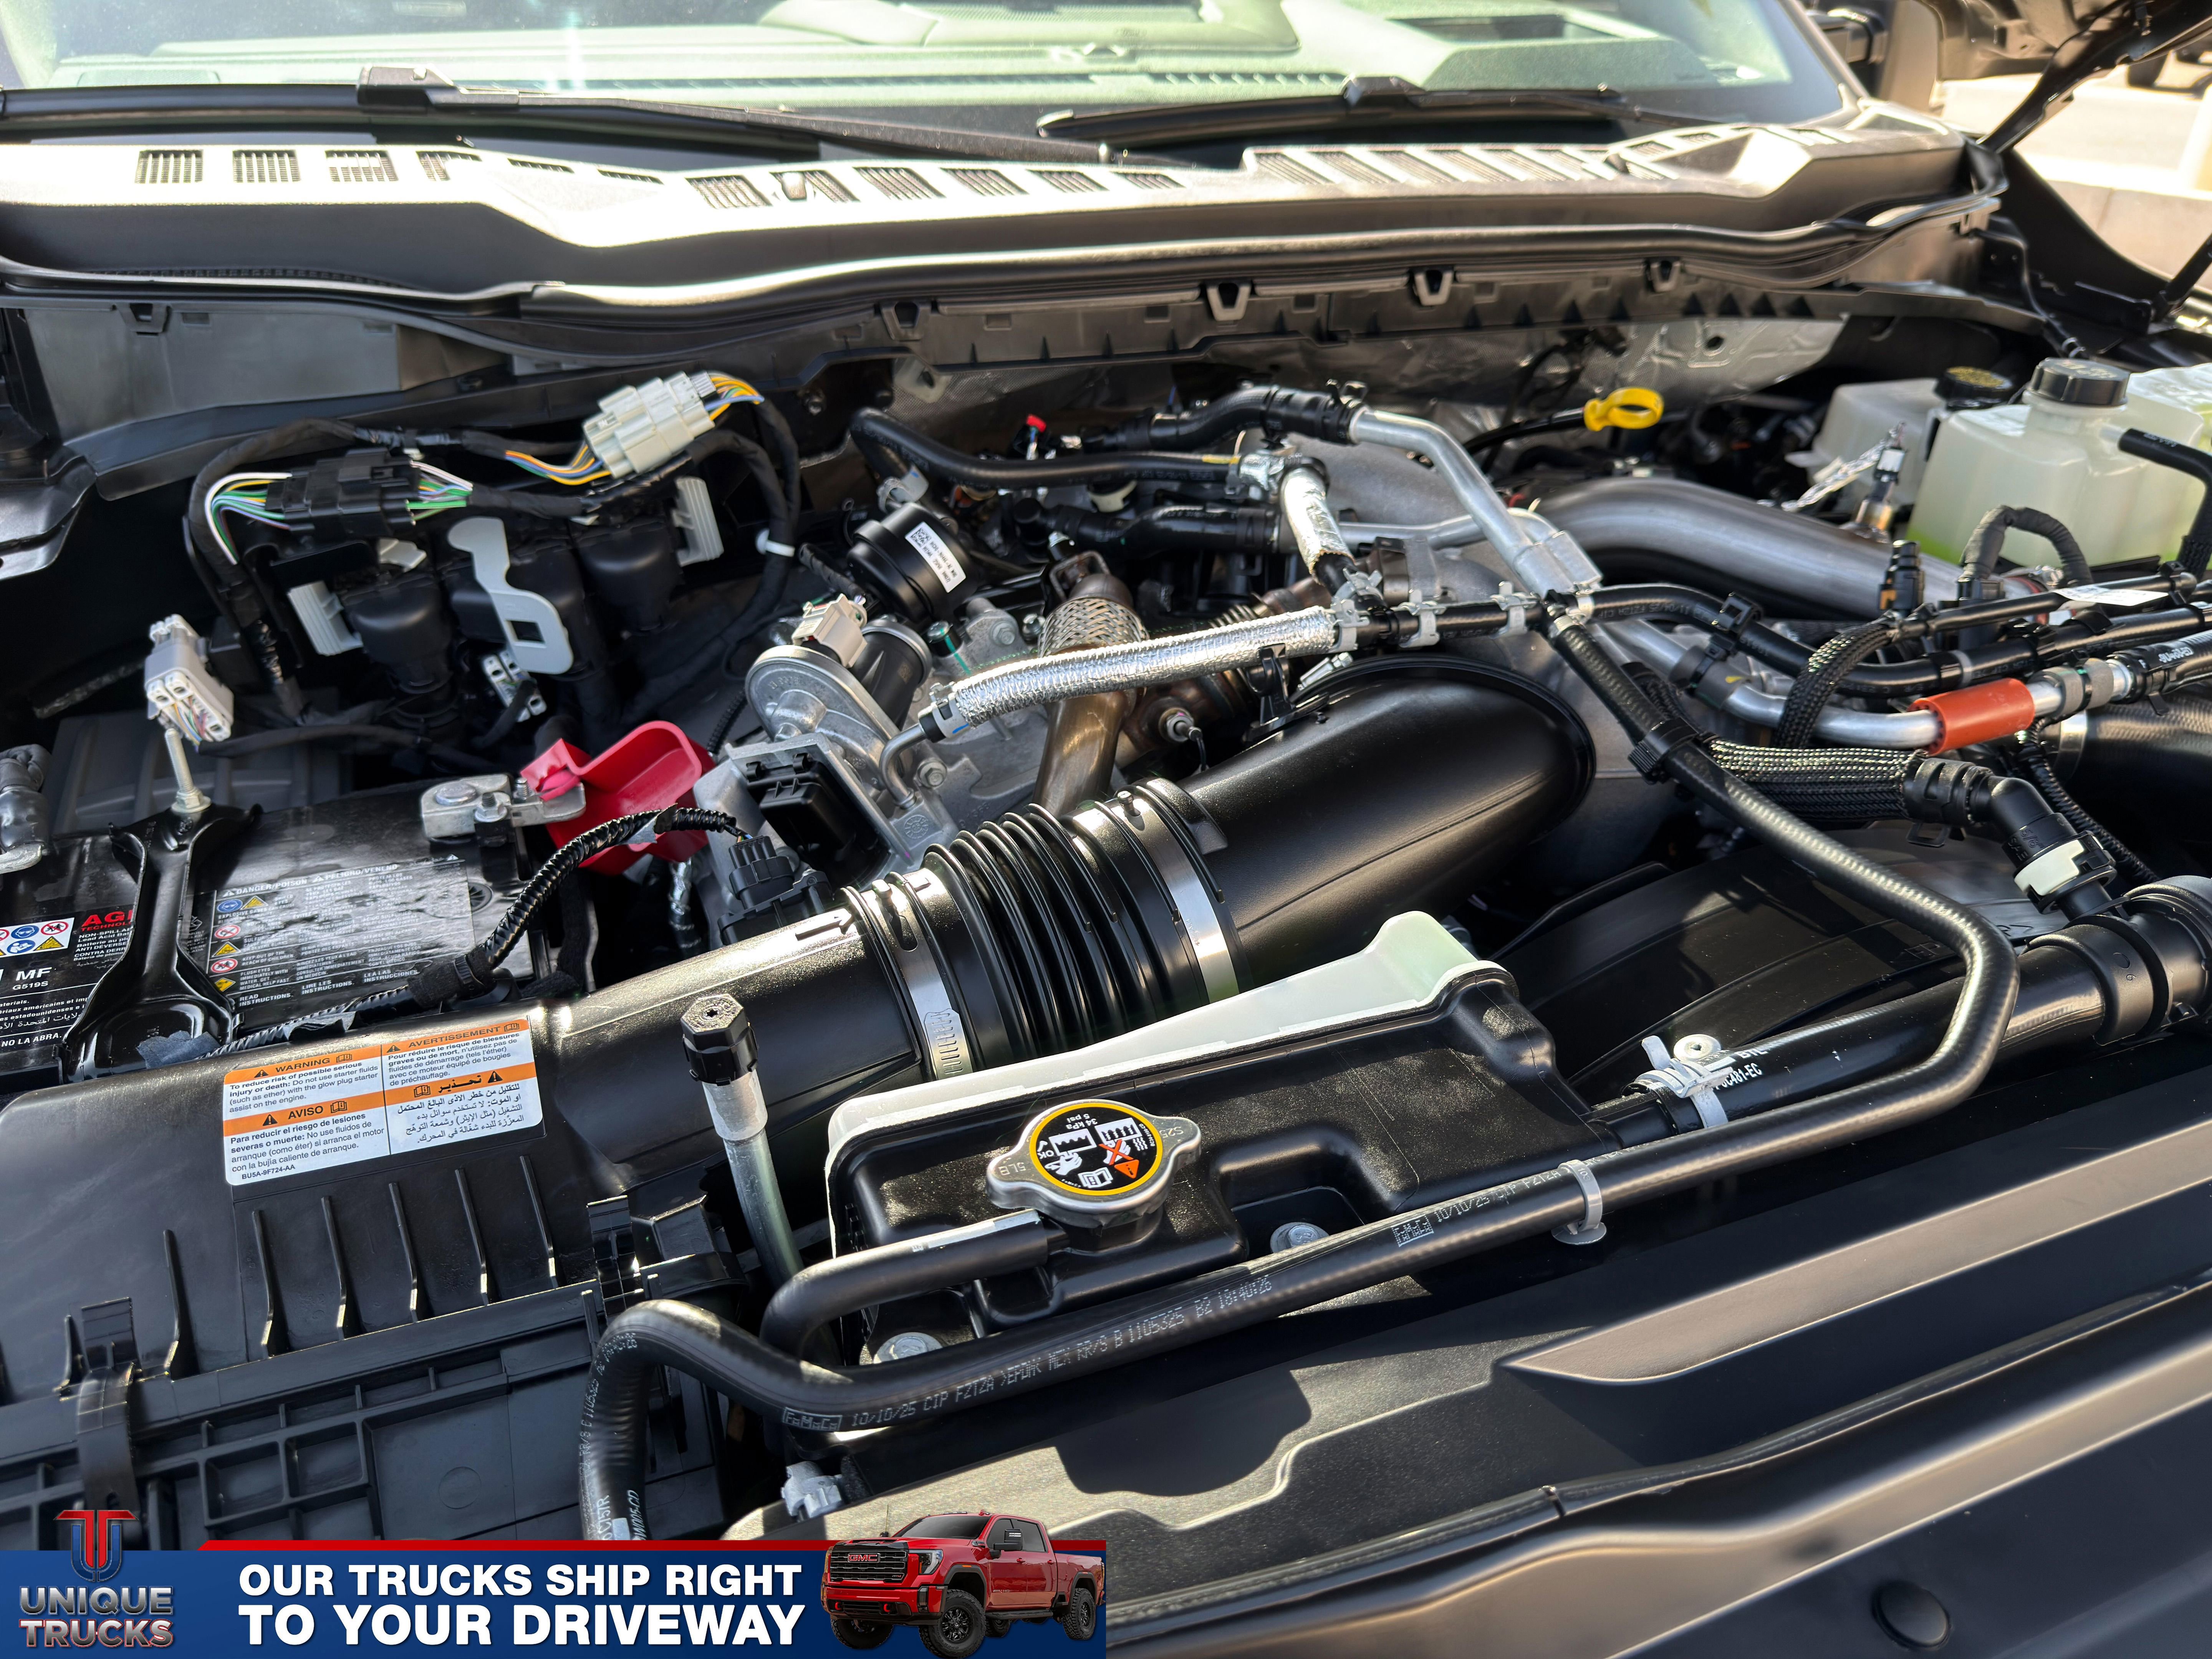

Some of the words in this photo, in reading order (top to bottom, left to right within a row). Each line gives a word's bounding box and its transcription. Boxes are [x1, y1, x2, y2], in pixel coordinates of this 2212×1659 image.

[236, 879, 308, 895] DANGER/POISON
[16, 967, 52, 981] MF
[13, 981, 48, 990] G519S
[301, 981, 354, 995] INSTRUCTIONS.
[239, 993, 293, 1007] INSTRUCTIONS.
[240, 994, 258, 1002] READ
[23, 1001, 65, 1011] américains
[10, 1007, 73, 1019] estadounidenses
[18, 1017, 50, 1027] المتحدة
[33, 1033, 62, 1042] ABRA.
[408, 1026, 501, 1048] AVERTISSEMENT
[483, 1034, 520, 1043] blessures
[388, 1058, 414, 1067] graves
[462, 1044, 492, 1053] n'utilisez
[389, 1065, 412, 1073] fluides
[425, 1055, 464, 1066] démarrage
[483, 1046, 507, 1055] l'éther)
[1735, 1049, 1768, 1058] BTL
[275, 1058, 330, 1073] WARNING
[419, 1065, 445, 1073] moteur
[446, 1059, 470, 1068] équipé
[483, 1053, 511, 1061] bougies
[242, 1080, 269, 1088] reduce
[298, 1068, 331, 1079] possible
[333, 1063, 362, 1071] serious
[401, 1071, 450, 1085] préchauffage.
[230, 1089, 253, 1097] injury
[265, 1082, 290, 1090] death:
[230, 1096, 250, 1106] (such
[263, 1089, 285, 1098] ether)
[318, 1081, 335, 1089] glow
[354, 1073, 378, 1081] starter
[439, 1075, 482, 1093] تحذير
[499, 1083, 520, 1094] للتقليل
[468, 1091, 483, 1101] خطر
[488, 1096, 511, 1107] الموت:
[229, 1104, 252, 1113] assist
[279, 1095, 306, 1103] engine.
[398, 1102, 424, 1114] المحتمل
[427, 1098, 445, 1109] البالغ
[453, 1103, 477, 1115] تستخدم
[288, 1106, 323, 1119] AVISO
[430, 1109, 451, 1118] سوائل
[1066, 1115, 1083, 1124] psi
[1066, 1121, 1085, 1130] kPa
[1086, 1118, 1098, 1126] 34
[252, 1129, 281, 1140] reducir
[293, 1123, 318, 1132] riesgo
[332, 1114, 366, 1124] lesiones
[231, 1143, 263, 1153] severas
[273, 1135, 305, 1145] muerte:
[336, 1124, 360, 1133] fluidos
[232, 1152, 267, 1163] arranque
[269, 1146, 293, 1157] (como
[295, 1141, 313, 1150] éter)
[323, 1135, 352, 1145] arranca
[363, 1128, 384, 1137] motor
[258, 1158, 277, 1167] bujía
[279, 1152, 309, 1163] caliente
[323, 1143, 359, 1154] arranque.
[1038, 1151, 1055, 1159] OK
[242, 1164, 296, 1179] BU5A-9F724-AA
[998, 1162, 1026, 1175] 5LB
[1061, 1179, 1081, 1188] FoMoCo
